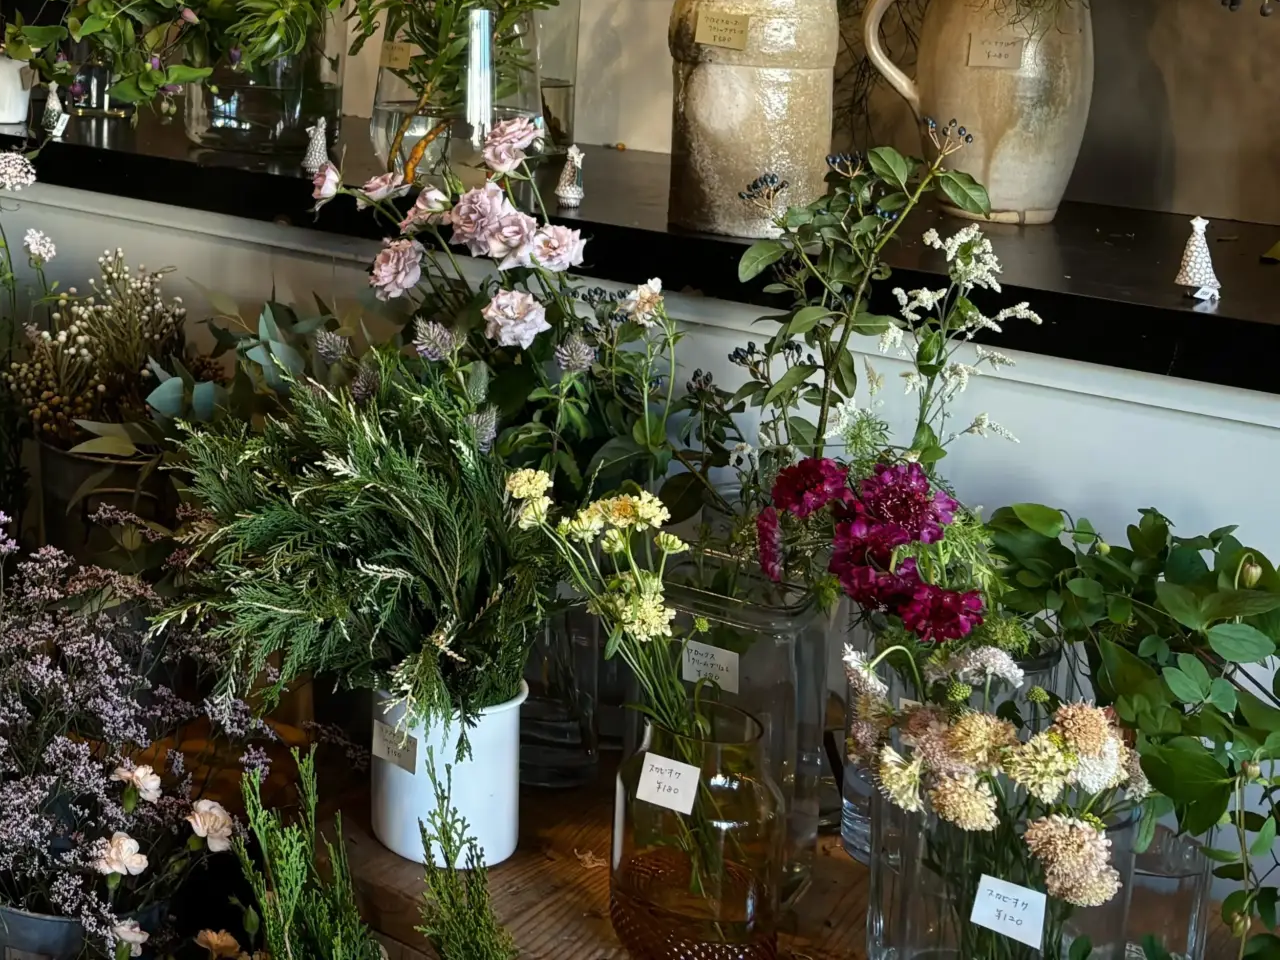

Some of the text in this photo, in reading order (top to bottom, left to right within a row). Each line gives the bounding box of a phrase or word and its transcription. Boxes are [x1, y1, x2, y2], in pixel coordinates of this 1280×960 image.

[656, 779, 680, 795] ¥180
[986, 888, 1029, 912] スカビオサ
[995, 907, 1024, 926] ¥120
